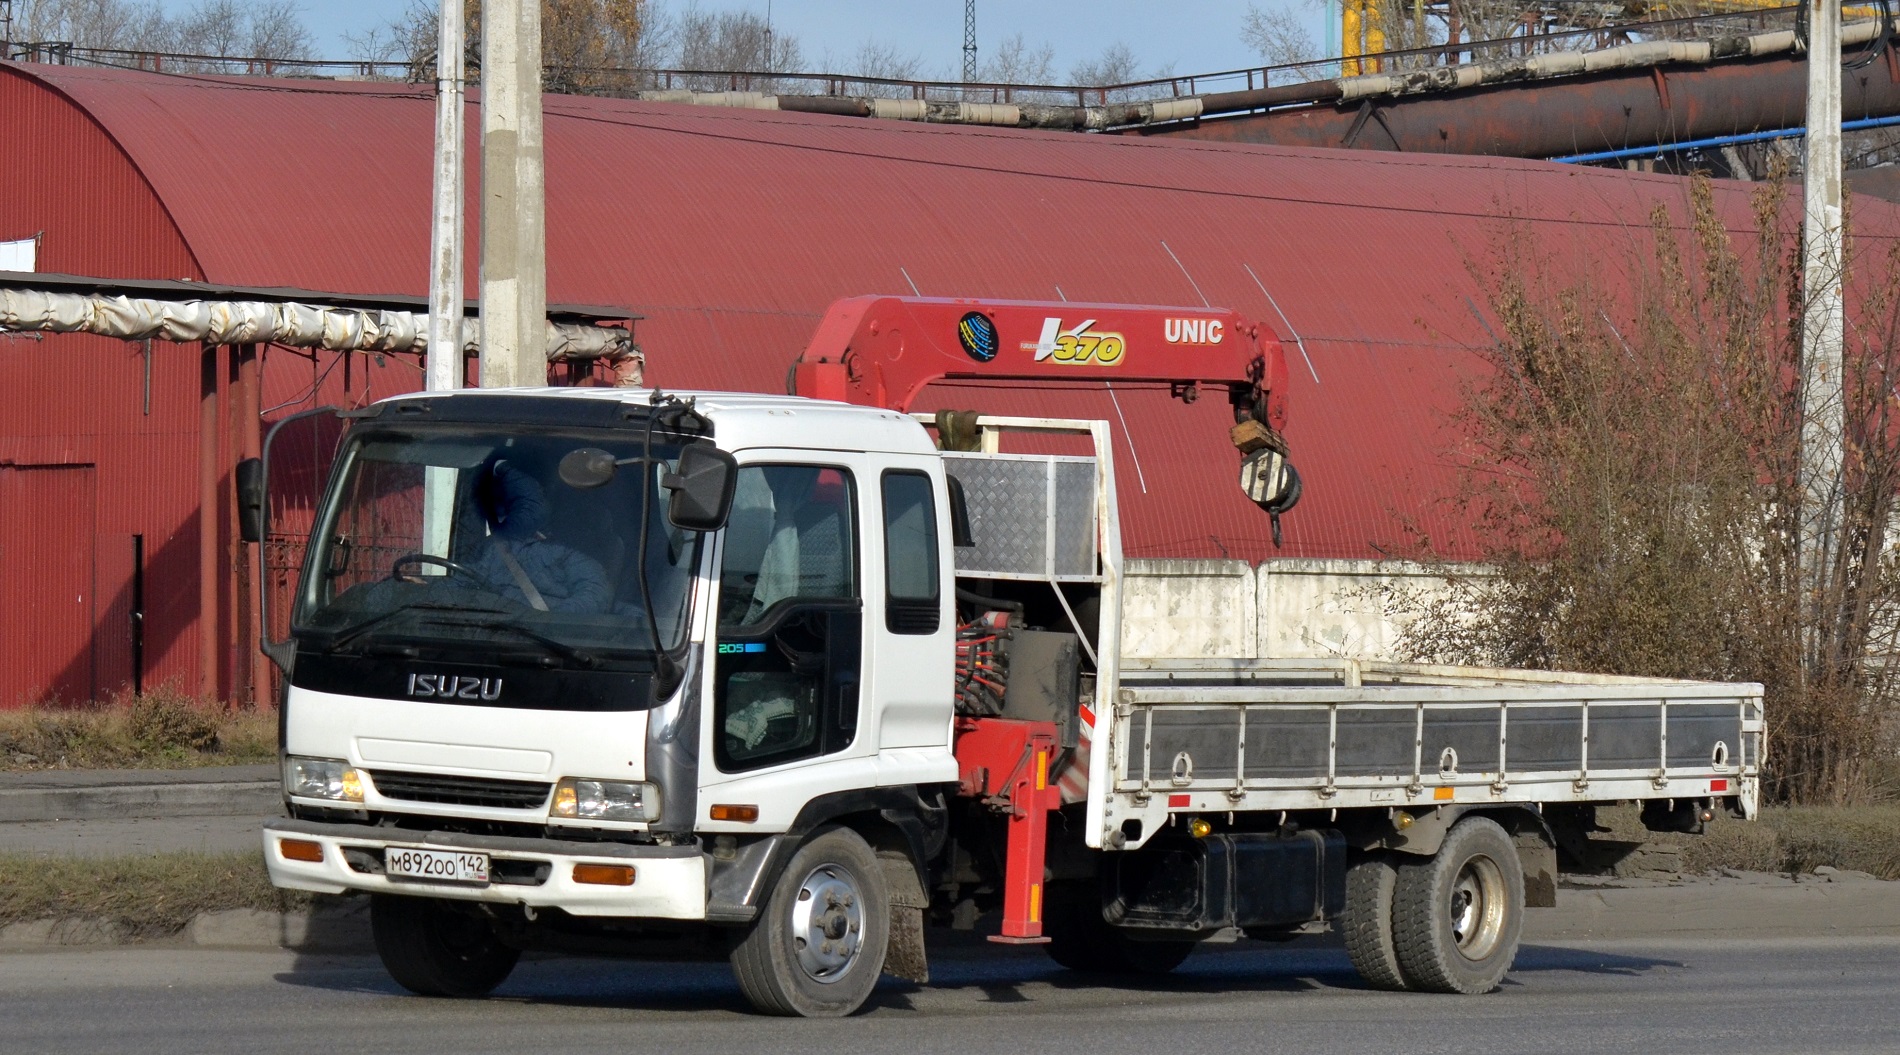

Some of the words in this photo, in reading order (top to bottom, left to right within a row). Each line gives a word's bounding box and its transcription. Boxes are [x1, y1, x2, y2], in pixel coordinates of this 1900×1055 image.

[1165, 319, 1223, 344] UNIC
[718, 643, 744, 653] 205
[407, 673, 503, 700] ISUZU
[459, 855, 484, 872] 142
[465, 871, 478, 879] RUS
